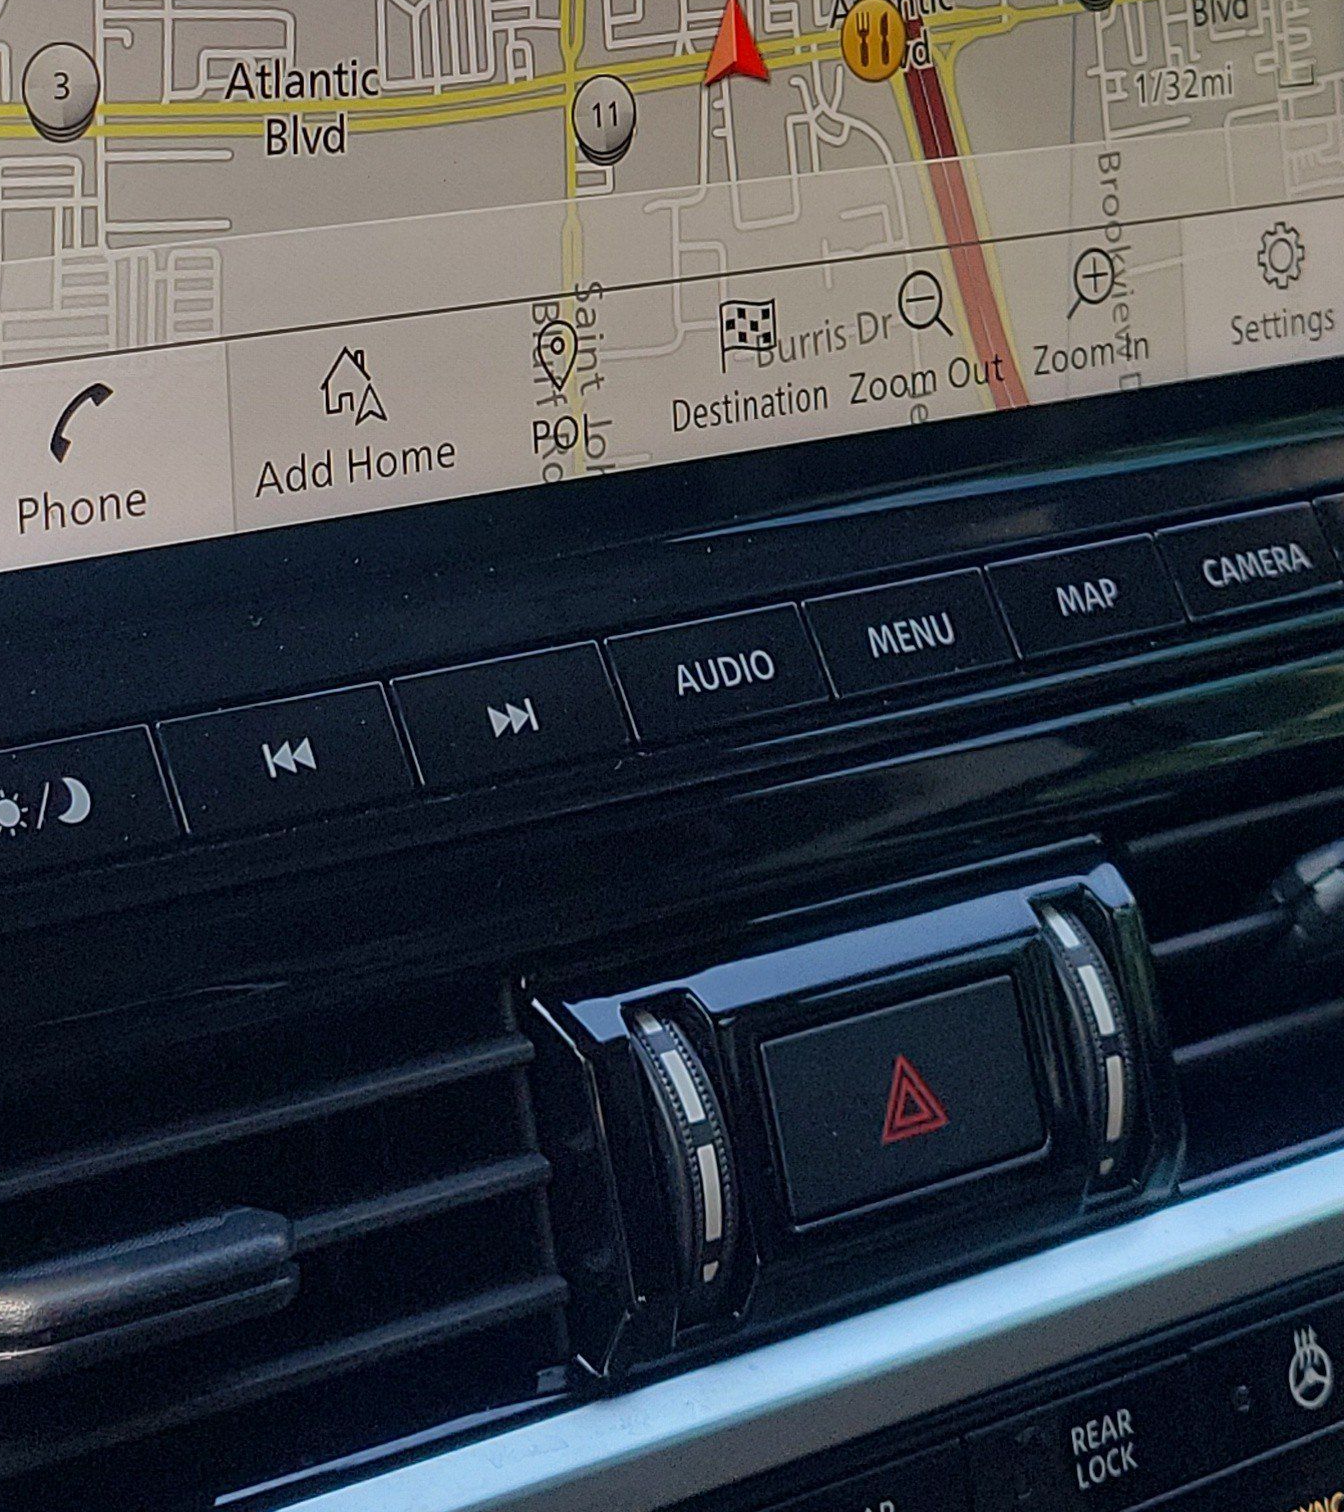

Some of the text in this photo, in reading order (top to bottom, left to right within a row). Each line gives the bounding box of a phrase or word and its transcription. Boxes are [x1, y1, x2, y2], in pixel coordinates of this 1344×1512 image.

[53, 72, 71, 100] 3
[225, 60, 379, 100] Atlantic
[1136, 65, 1233, 104] 1/32mi
[266, 114, 346, 156] Blvd
[592, 101, 618, 128] 11
[857, 311, 892, 345] Dr
[1231, 307, 1336, 346] Settings
[849, 369, 936, 405] Zoom
[948, 352, 1006, 388] Out
[1034, 341, 1114, 376] Zoom
[673, 382, 828, 432] Destination
[533, 414, 589, 454] POI
[256, 440, 455, 498] Add Home
[18, 489, 147, 534] Phone
[1203, 543, 1314, 588] CAMERA
[1056, 578, 1118, 617] MAP
[867, 612, 954, 658] MENU
[677, 649, 775, 696] AUDIO
[1071, 1408, 1134, 1457] REAR
[1076, 1445, 1138, 1490] LOCK
